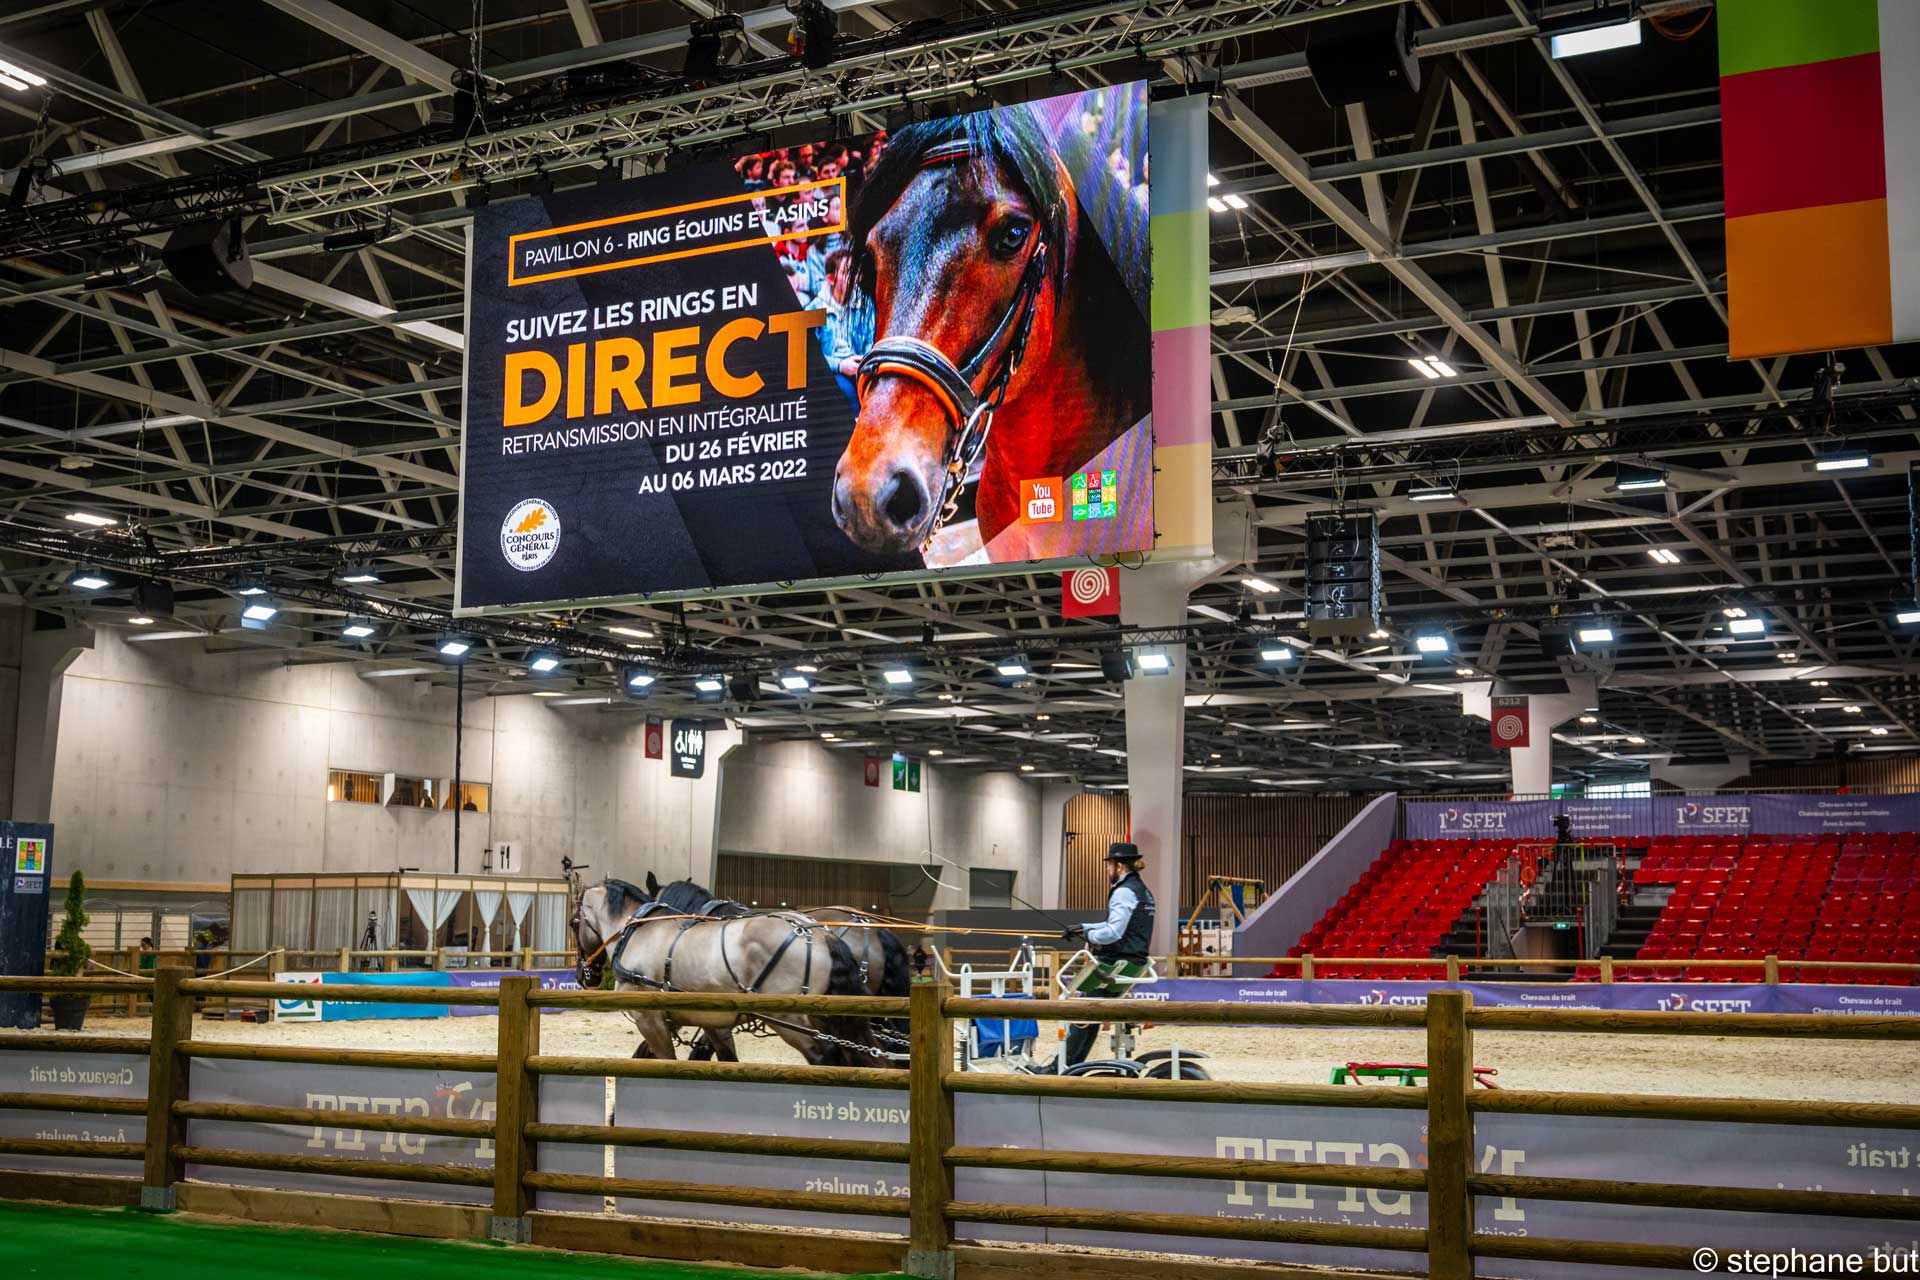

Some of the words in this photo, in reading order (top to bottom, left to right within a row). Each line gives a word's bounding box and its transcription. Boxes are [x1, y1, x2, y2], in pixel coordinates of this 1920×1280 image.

[525, 239, 600, 267] PAVILLON
[604, 236, 613, 254] 6
[627, 226, 671, 249] RING
[675, 214, 744, 242] ÉQUINS
[747, 210, 770, 229] ET
[774, 198, 829, 224] ASINS
[505, 309, 587, 343] SUIVEZ
[593, 302, 634, 330] LES
[640, 289, 715, 323] RINGS
[721, 283, 758, 311] EN
[503, 308, 827, 427] DIRECT
[502, 420, 653, 456] RETRANSMISSION
[658, 415, 684, 437] EN
[688, 395, 807, 433] INTÉGRALITÉ
[665, 443, 693, 464] DU
[698, 439, 722, 460] 26
[727, 430, 807, 457] FÉVRIER
[638, 474, 667, 495] AU
[671, 471, 694, 490] 06
[699, 464, 755, 488] MARS
[759, 458, 807, 482] 2022
[1033, 483, 1051, 499] You
[1032, 503, 1052, 515] Tube
[506, 532, 555, 544] CONCOURS
[510, 542, 550, 553] GÉNÉRAL
[1462, 812, 1506, 828] SFET
[1703, 807, 1751, 823] SFET
[1520, 993, 1551, 1001] Chevaux
[1551, 993, 1560, 1001] de
[1560, 993, 1577, 1001] trait
[1838, 996, 1873, 1004] Chevaux
[1874, 997, 1884, 1005] de
[1885, 997, 1903, 1005] trait
